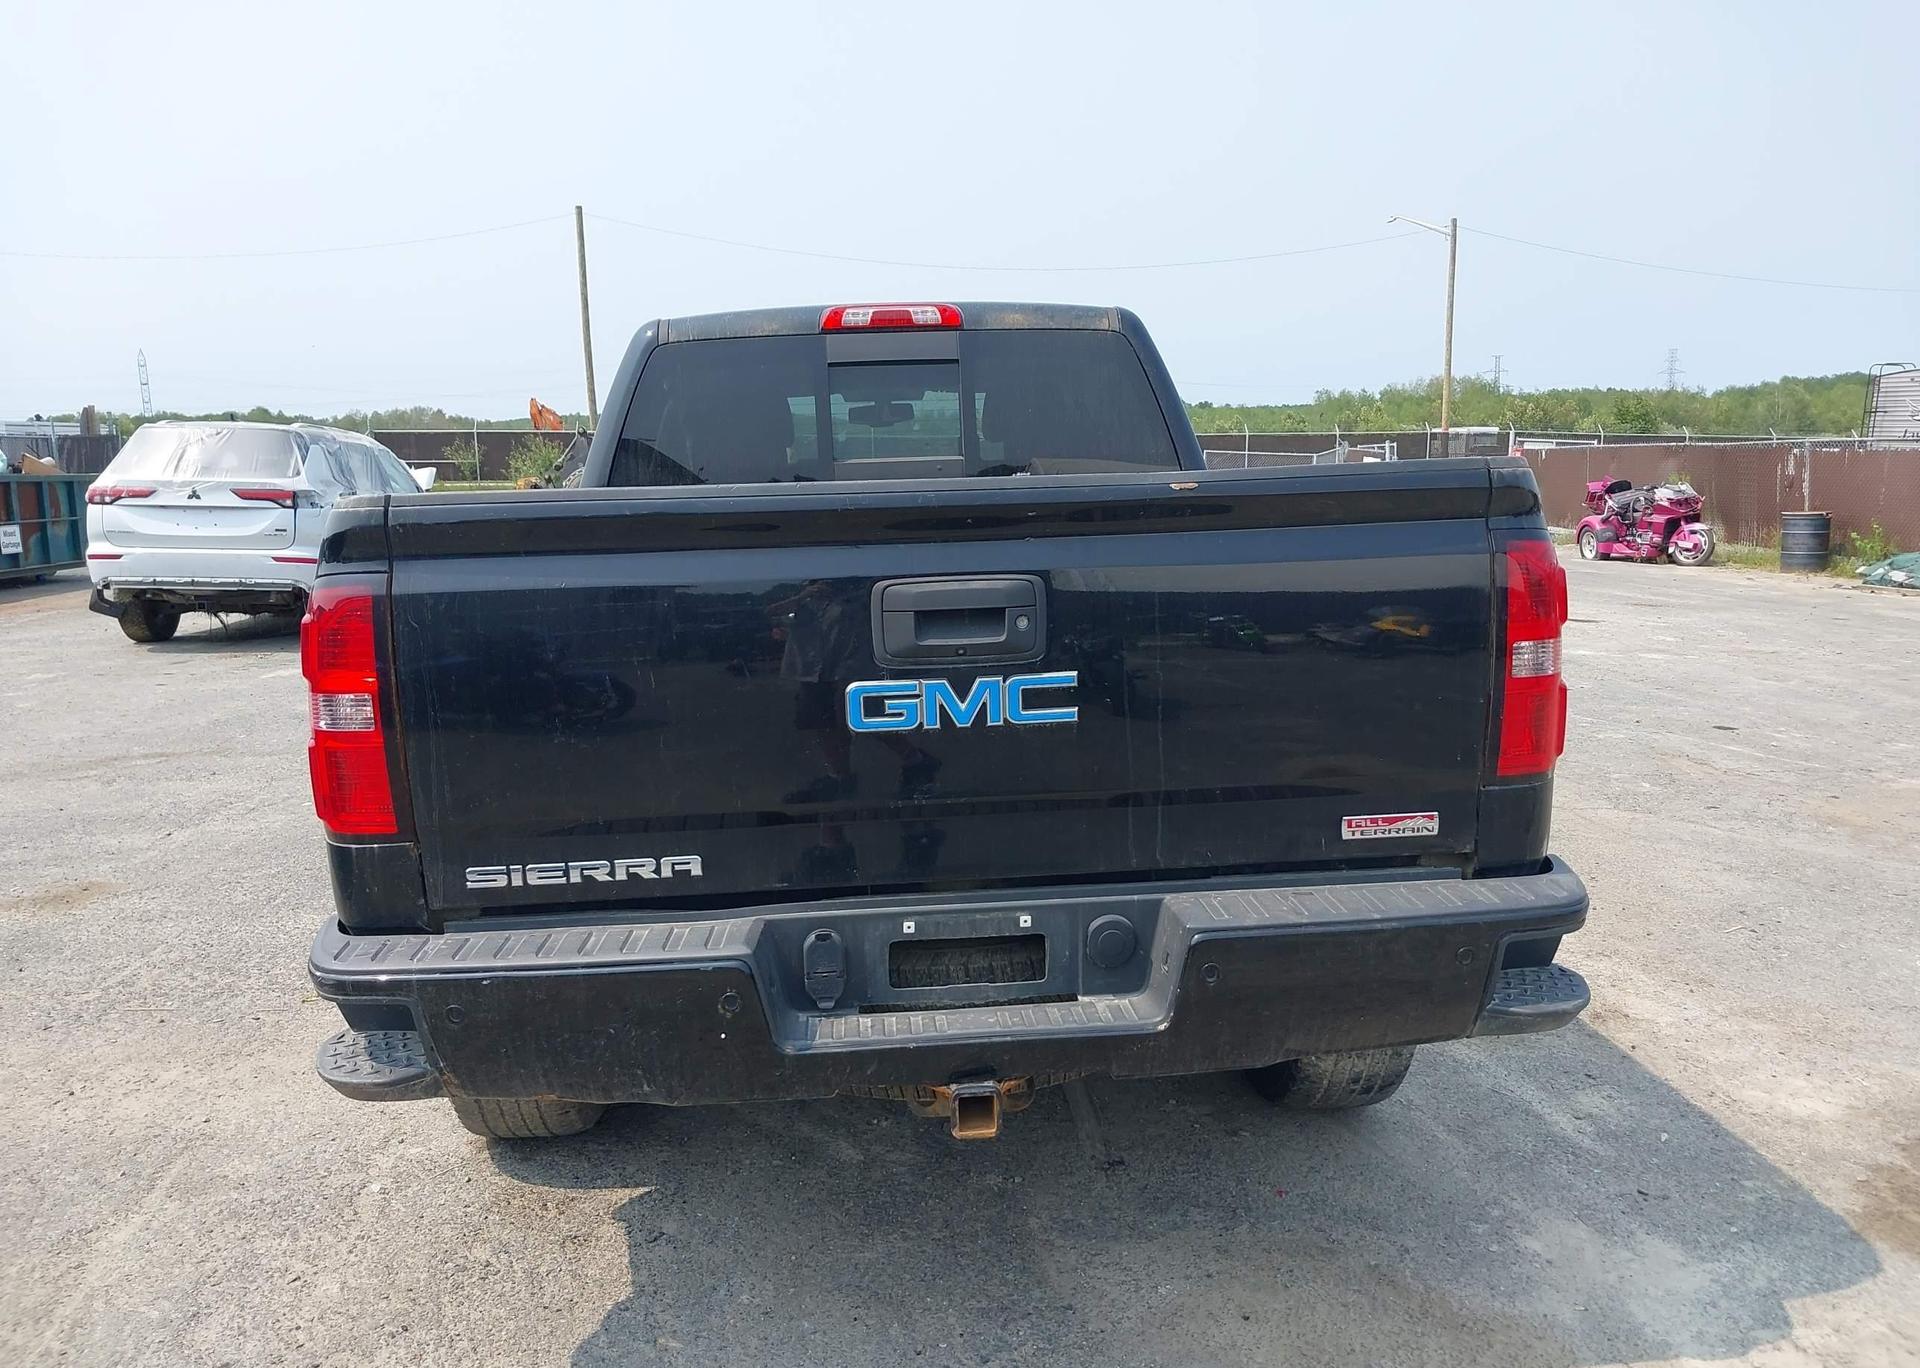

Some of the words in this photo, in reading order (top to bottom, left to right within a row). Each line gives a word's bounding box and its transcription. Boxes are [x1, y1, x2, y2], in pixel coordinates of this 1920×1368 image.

[845, 671, 1078, 732] GMC
[1347, 825, 1434, 837] TERRAIN
[1351, 818, 1389, 828] ALL
[465, 855, 703, 889] SIERRA
